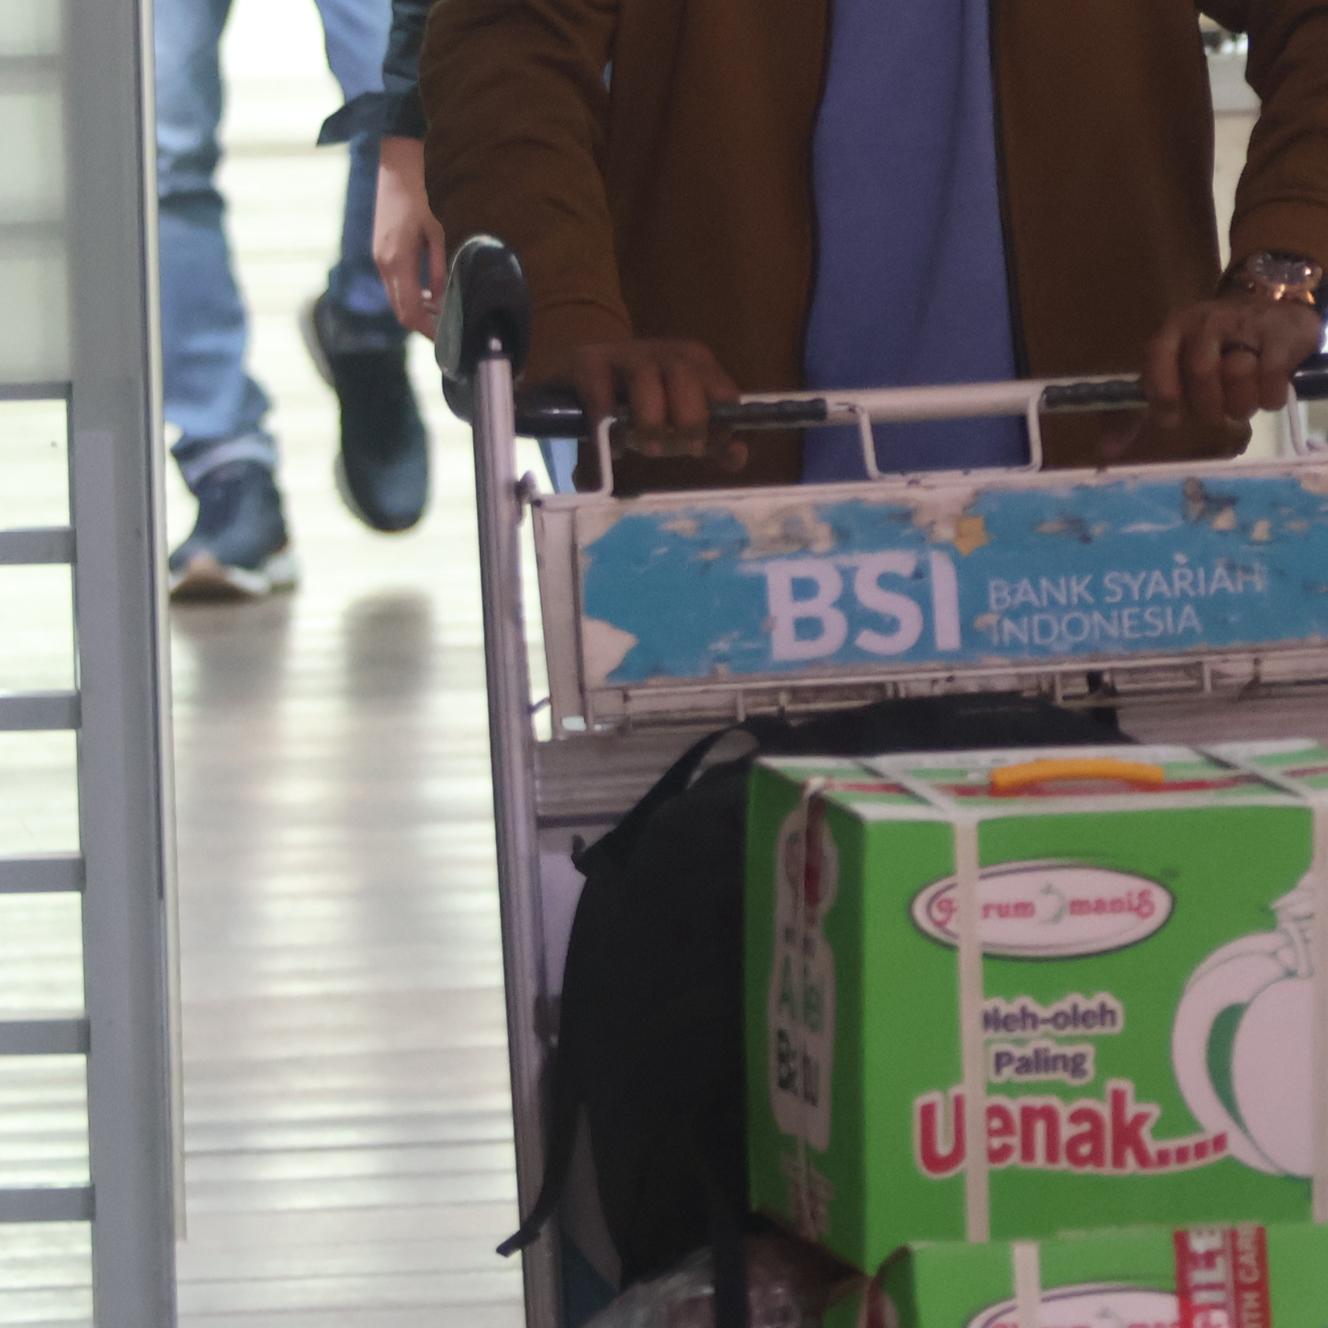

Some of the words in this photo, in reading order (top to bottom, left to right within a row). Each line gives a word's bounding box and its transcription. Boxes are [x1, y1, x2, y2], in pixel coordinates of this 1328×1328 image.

[766, 549, 960, 662] BSI
[989, 574, 1095, 611] BANK
[1103, 562, 1265, 604] SYARIAH
[991, 603, 1202, 647] INDONESIA
[983, 1001, 1117, 1032] leh-oleh
[994, 1047, 1087, 1079] Paling
